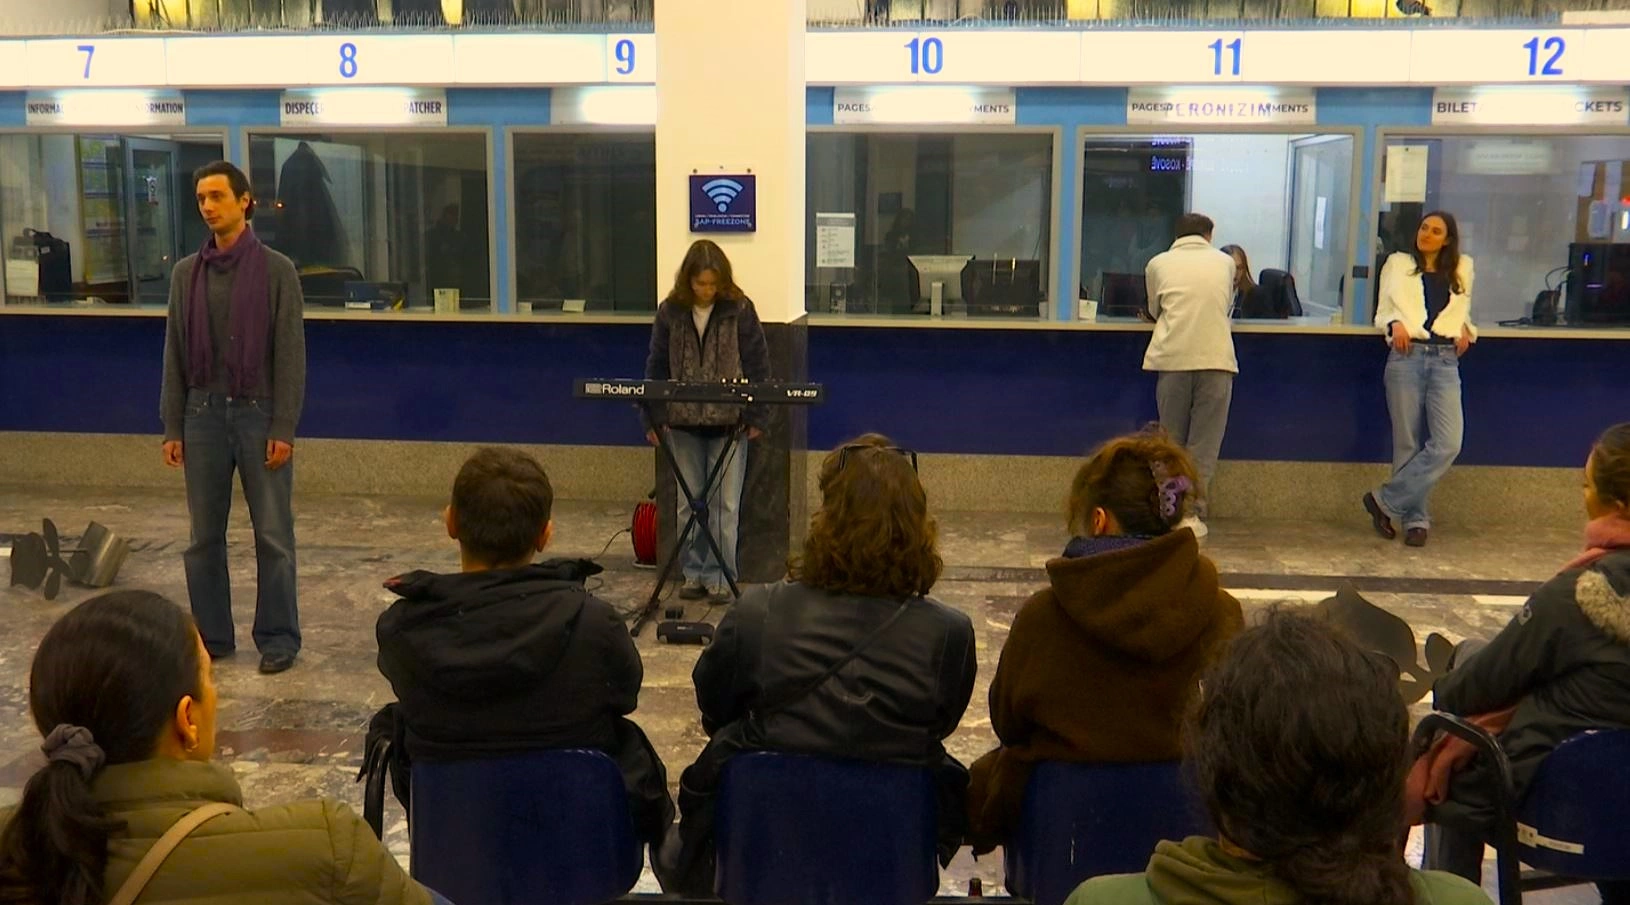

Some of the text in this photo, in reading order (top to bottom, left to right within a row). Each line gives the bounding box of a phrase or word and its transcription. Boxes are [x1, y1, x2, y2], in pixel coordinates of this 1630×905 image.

[77, 45, 95, 79] 7
[338, 42, 358, 78] 8
[614, 39, 636, 75] 9
[903, 37, 944, 75] 10
[1208, 37, 1243, 76] 11
[1522, 36, 1566, 76] 12
[837, 103, 871, 112] PAGES
[1437, 101, 1478, 113] BILET
[602, 383, 818, 398] Roland VR-09
